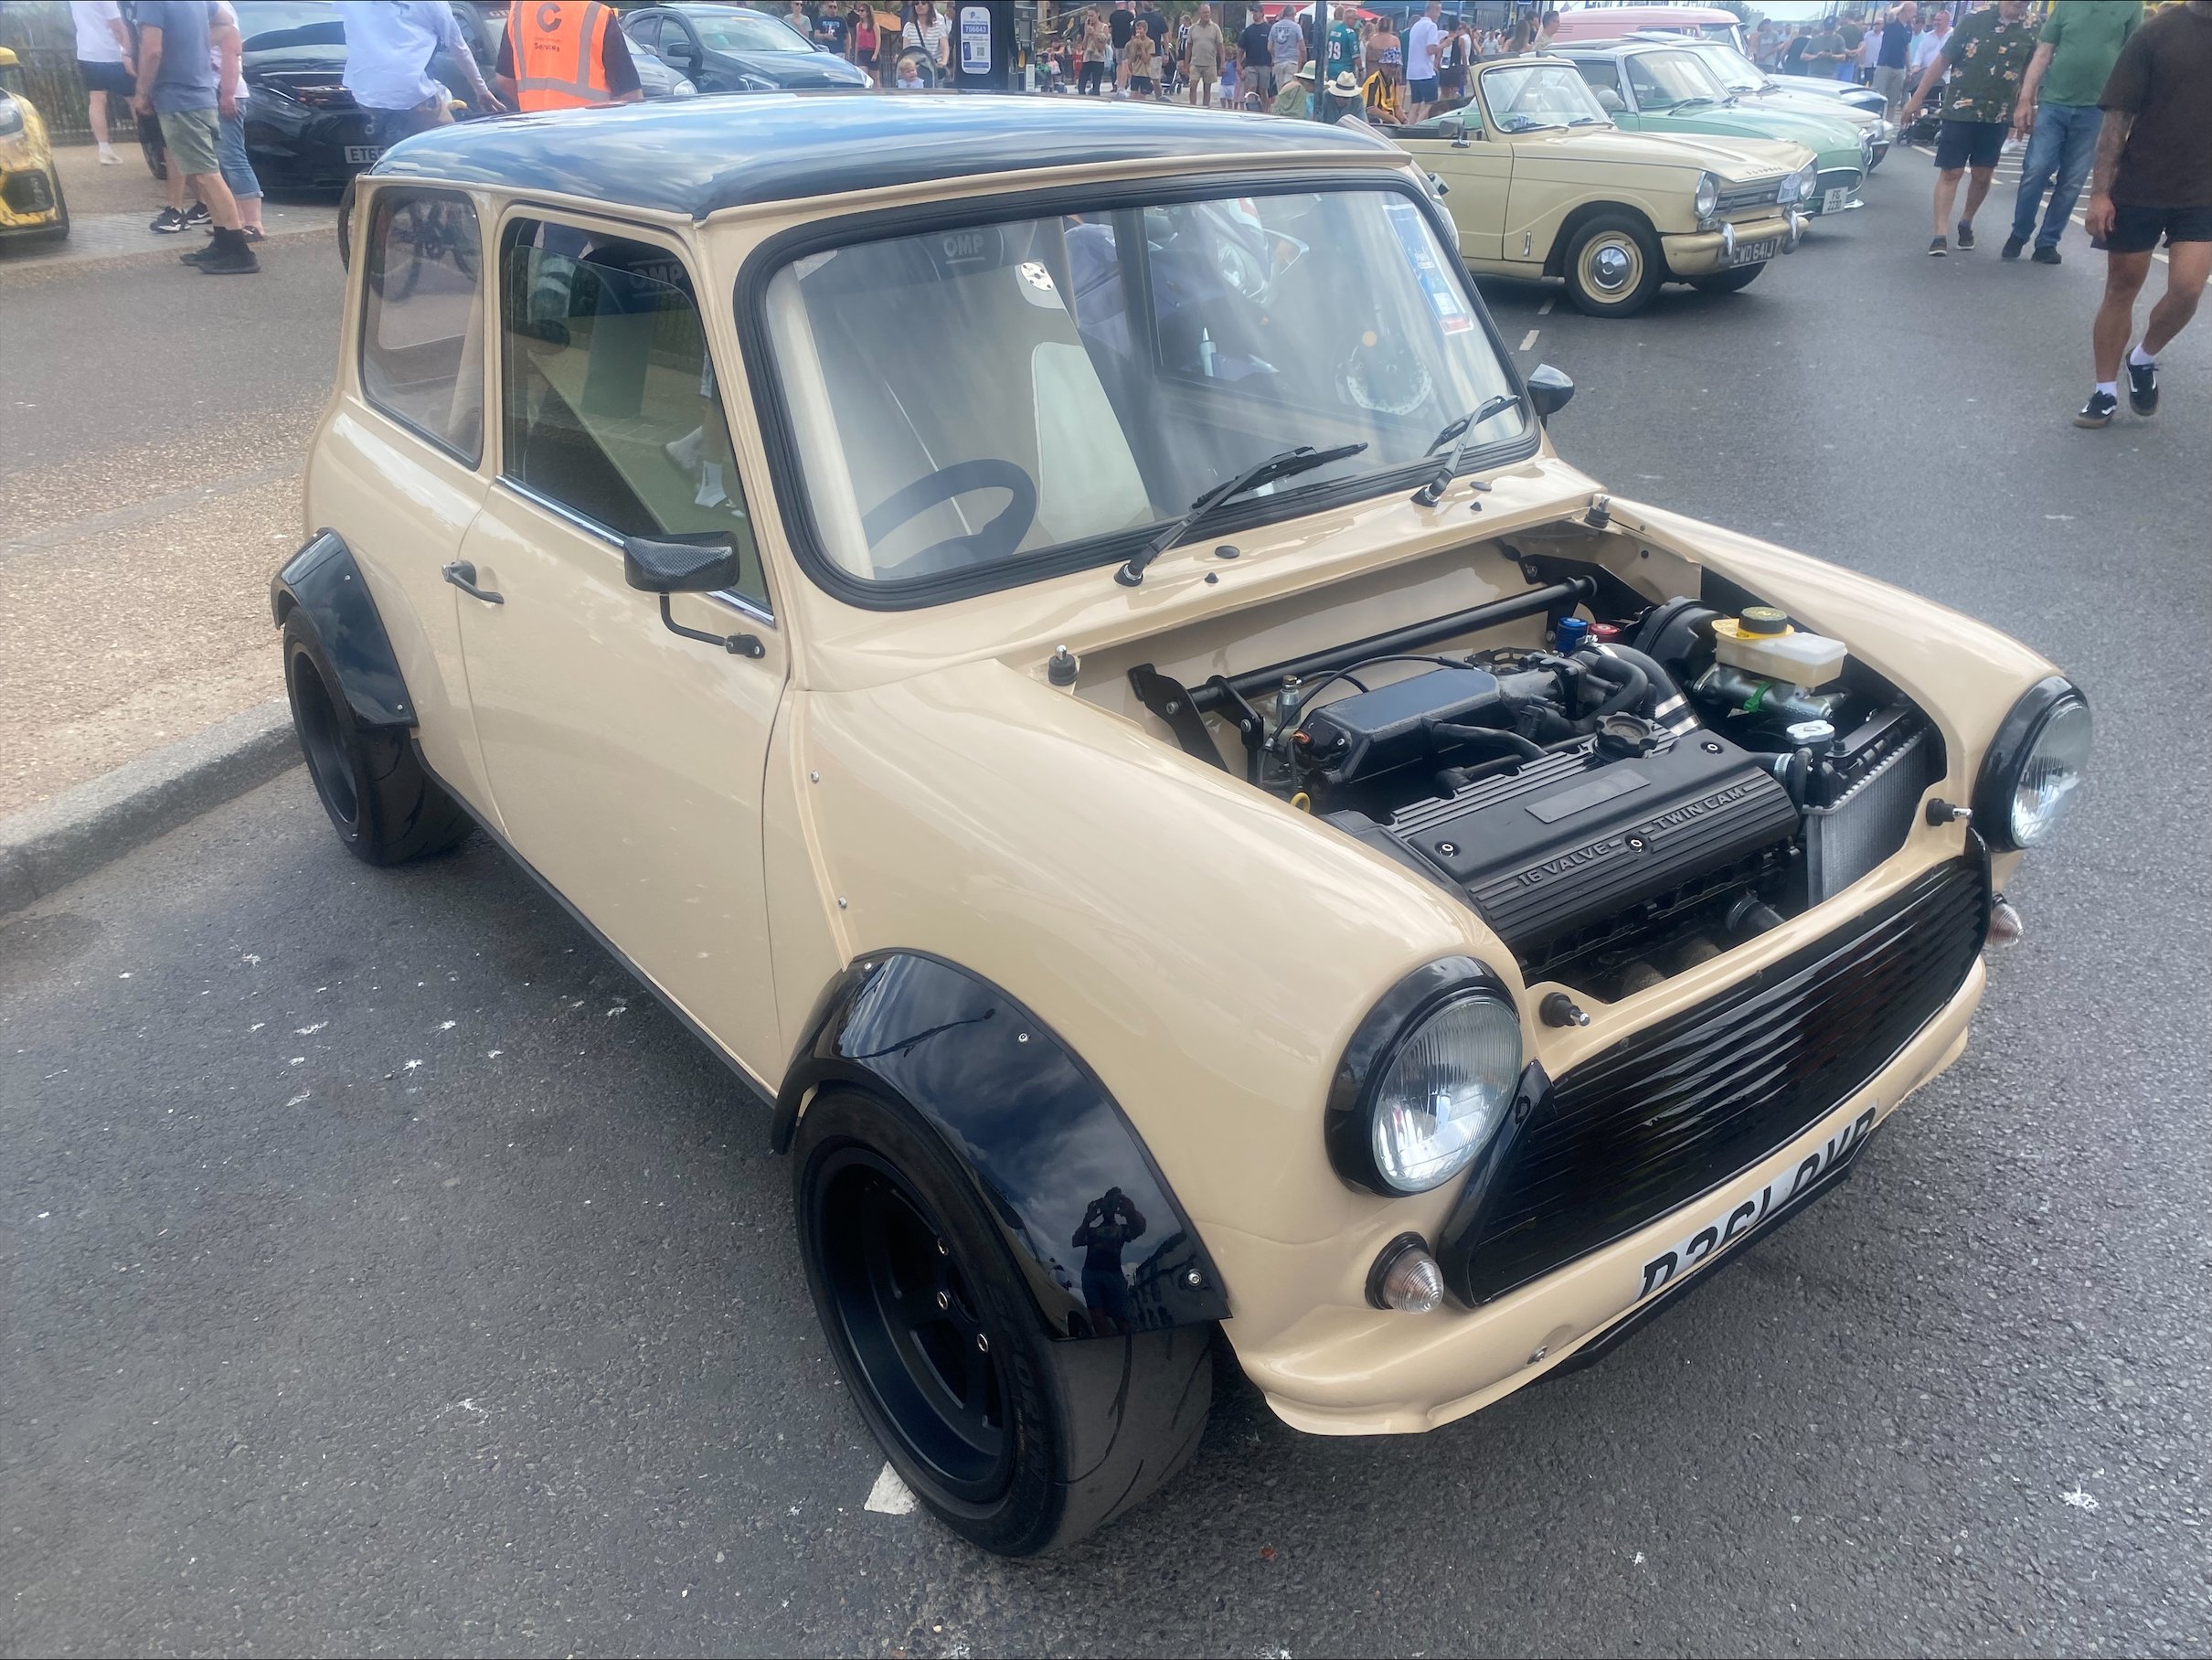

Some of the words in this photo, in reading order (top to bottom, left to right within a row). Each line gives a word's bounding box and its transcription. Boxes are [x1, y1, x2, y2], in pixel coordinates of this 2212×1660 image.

[943, 233, 984, 257] OMP
[629, 264, 684, 290] OMP
[1518, 868, 1544, 886] 16
[1542, 842, 1610, 875] VALVE
[1653, 804, 1705, 830] TWIN
[1706, 787, 1745, 811] CAM
